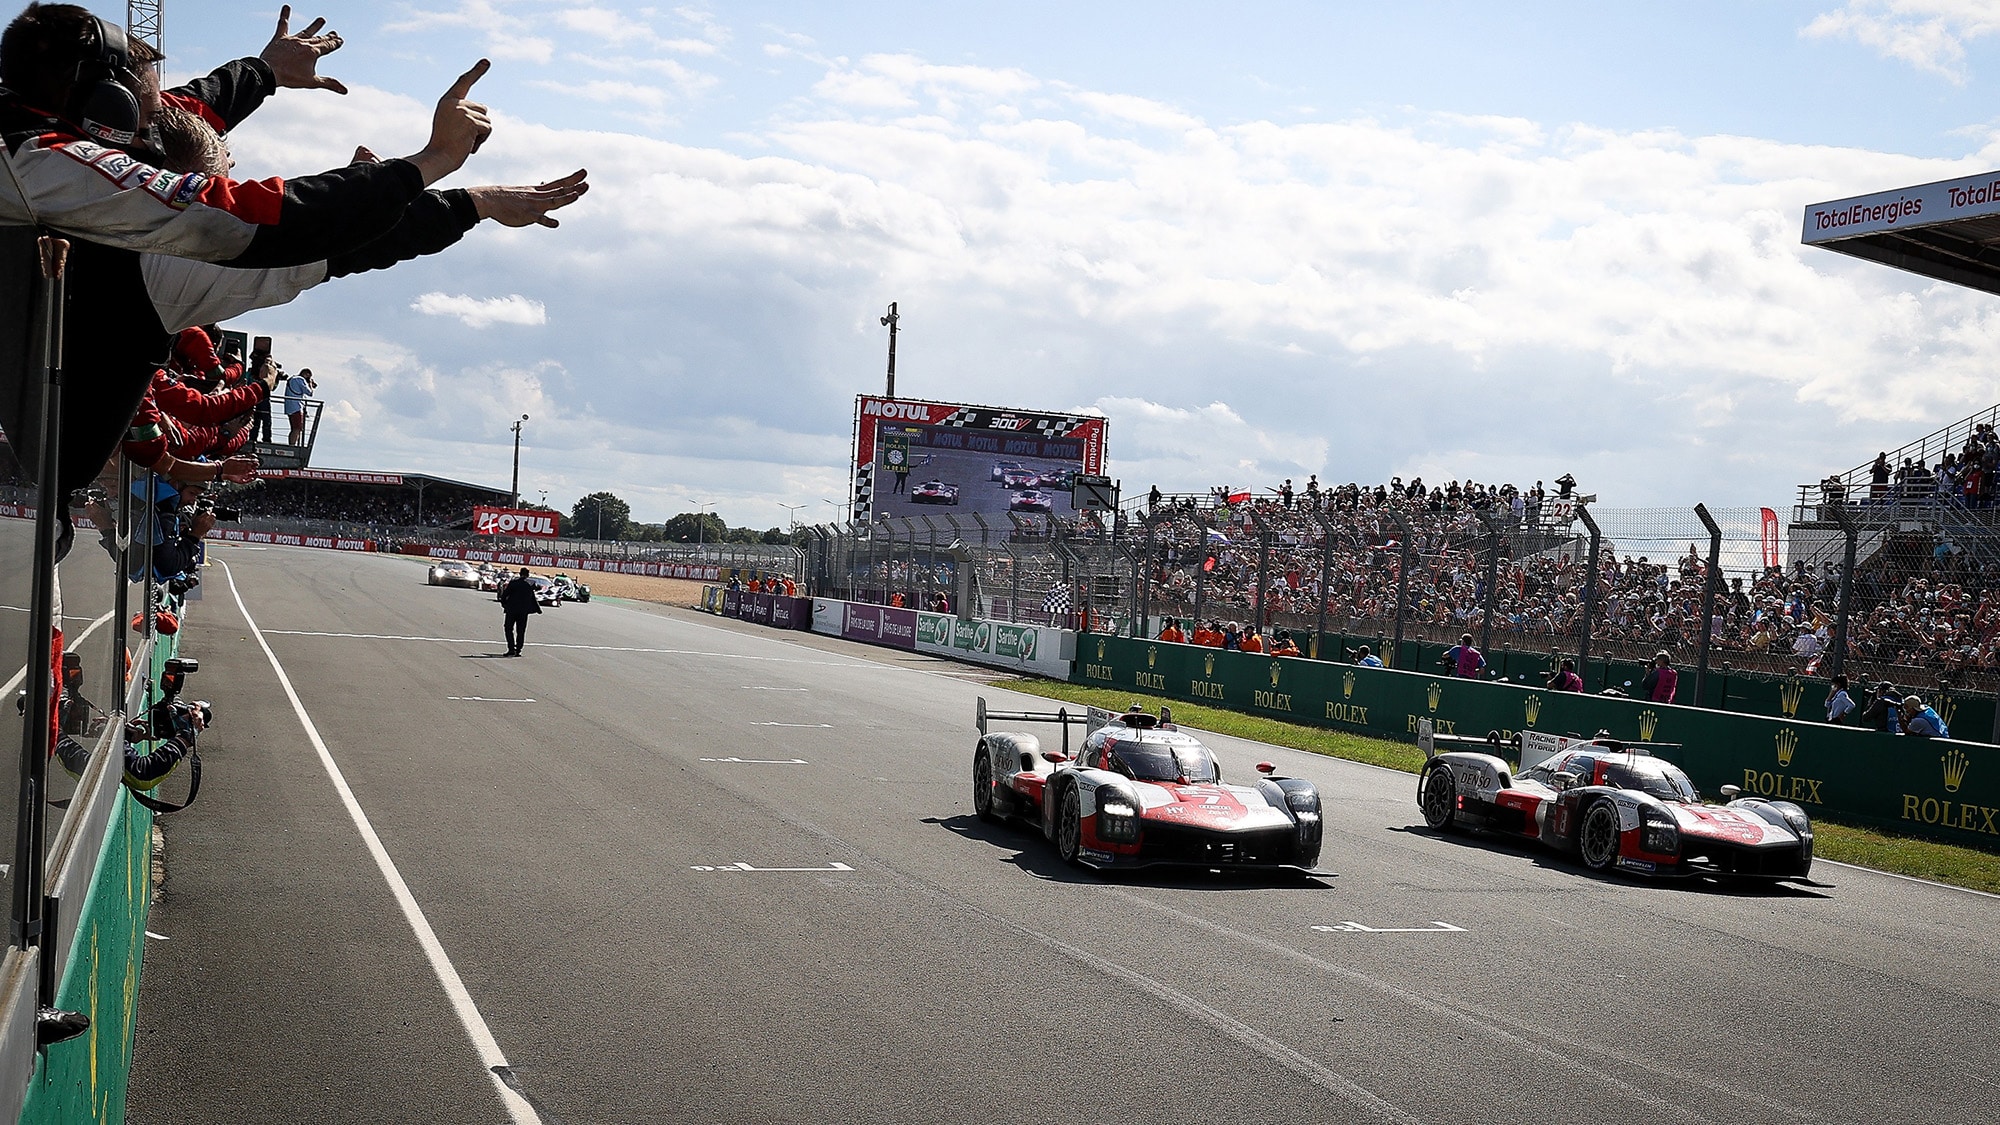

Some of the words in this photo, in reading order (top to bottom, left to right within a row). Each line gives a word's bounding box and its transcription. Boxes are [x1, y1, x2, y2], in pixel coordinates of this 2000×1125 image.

[1815, 196, 1923, 230] TotalEnergies
[863, 400, 930, 421] MOTUL
[988, 417, 1032, 430] 300V
[1004, 440, 1038, 456] MOTUL
[1043, 443, 1078, 458] MOTUL
[1088, 427, 1100, 469] Perpetual
[1554, 503, 1571, 517] 22
[477, 512, 554, 534] MOTUL
[248, 532, 271, 543] MOTUL
[275, 535, 300, 545] MOTUL
[304, 537, 332, 548] MOTUL
[336, 539, 364, 550] MOTUL
[429, 547, 459, 558] MOTUL
[465, 550, 493, 561] MOTUL
[498, 553, 524, 564] MOTUL
[529, 555, 553, 567] MOTUL
[556, 560, 579, 569] MOTUL
[919, 617, 935, 632] Sarthe
[955, 622, 974, 639] Sarthe
[998, 628, 1018, 646] Sarthe
[1086, 663, 1113, 681] ROLEX
[1136, 671, 1165, 691] ROLEX
[1191, 680, 1224, 700] ROLEX
[1254, 689, 1292, 712] ROLEX
[1326, 701, 1368, 725] ROLEX
[1527, 743, 1556, 752] HYBRID
[1529, 733, 1556, 744] RACING
[1461, 772, 1491, 788] DENSO
[1743, 768, 1823, 804] ROLEX
[1191, 795, 1221, 804] 7
[1165, 806, 1185, 814] HY
[1902, 794, 2000, 835] ROLEX
[1560, 810, 1567, 833] 8
[1626, 860, 1652, 869] MICHELIN
